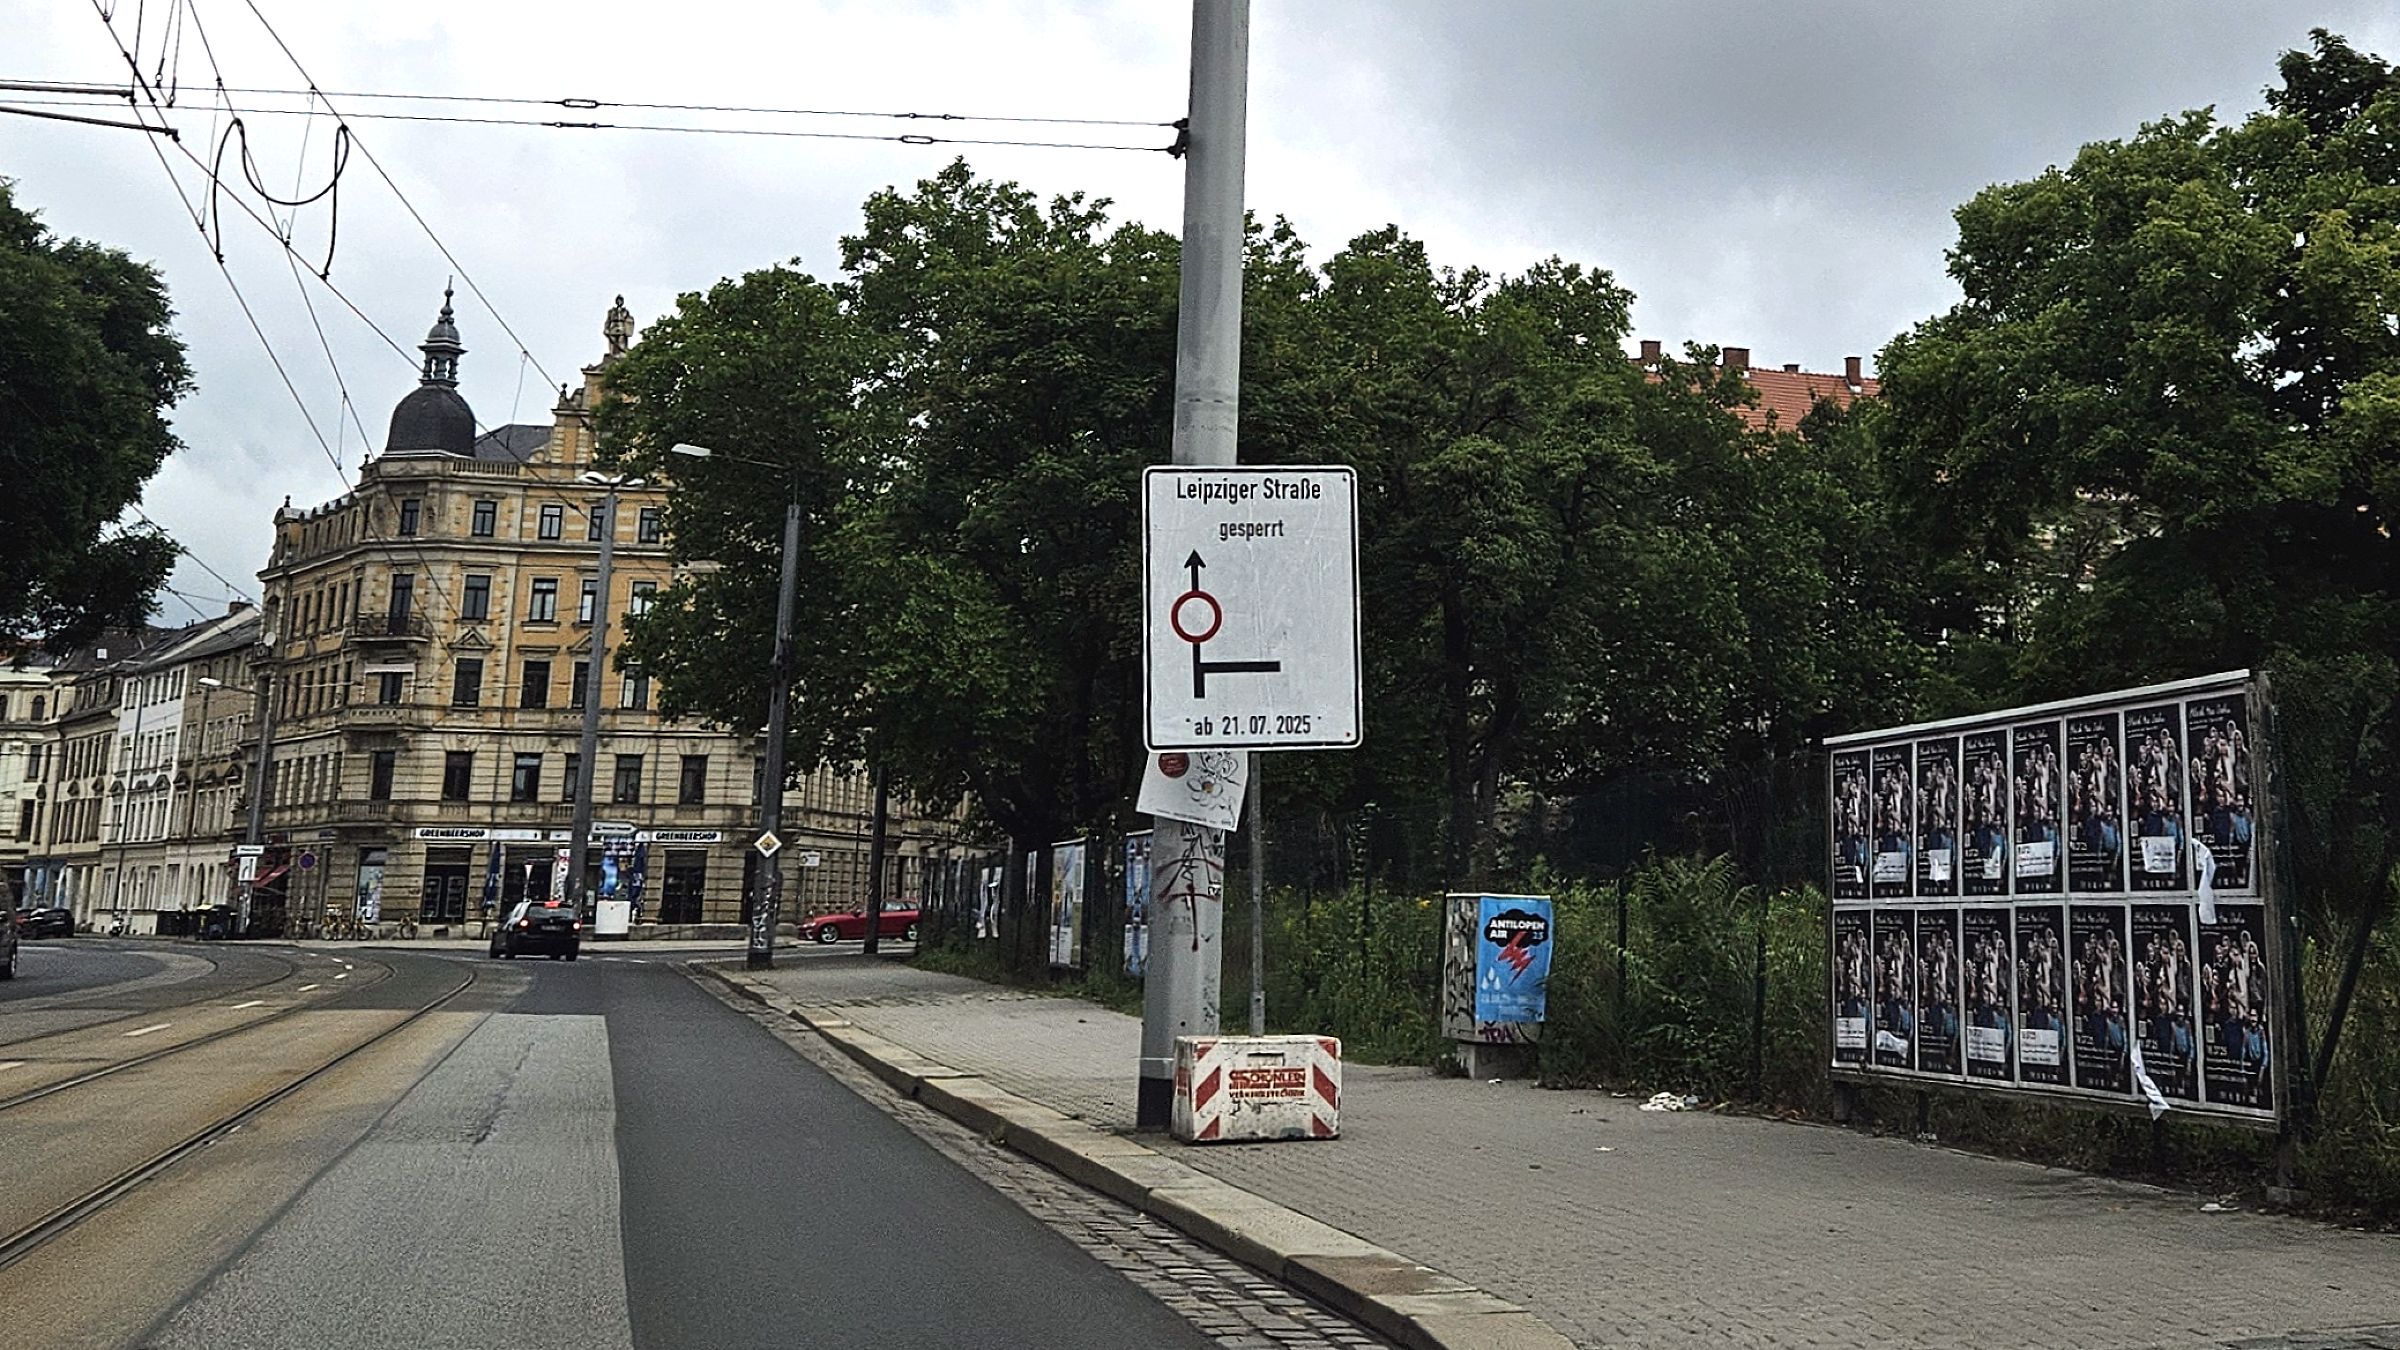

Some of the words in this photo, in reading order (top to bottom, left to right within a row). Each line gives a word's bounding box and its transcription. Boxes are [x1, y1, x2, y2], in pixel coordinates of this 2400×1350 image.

[1176, 477, 1259, 505] Leipziger
[1263, 477, 1321, 499] Straße
[1219, 520, 1284, 541] gesperrt
[1194, 716, 1213, 736] ab
[1489, 919, 1546, 930] ANTILOPEN
[1489, 929, 1508, 939] AIR
